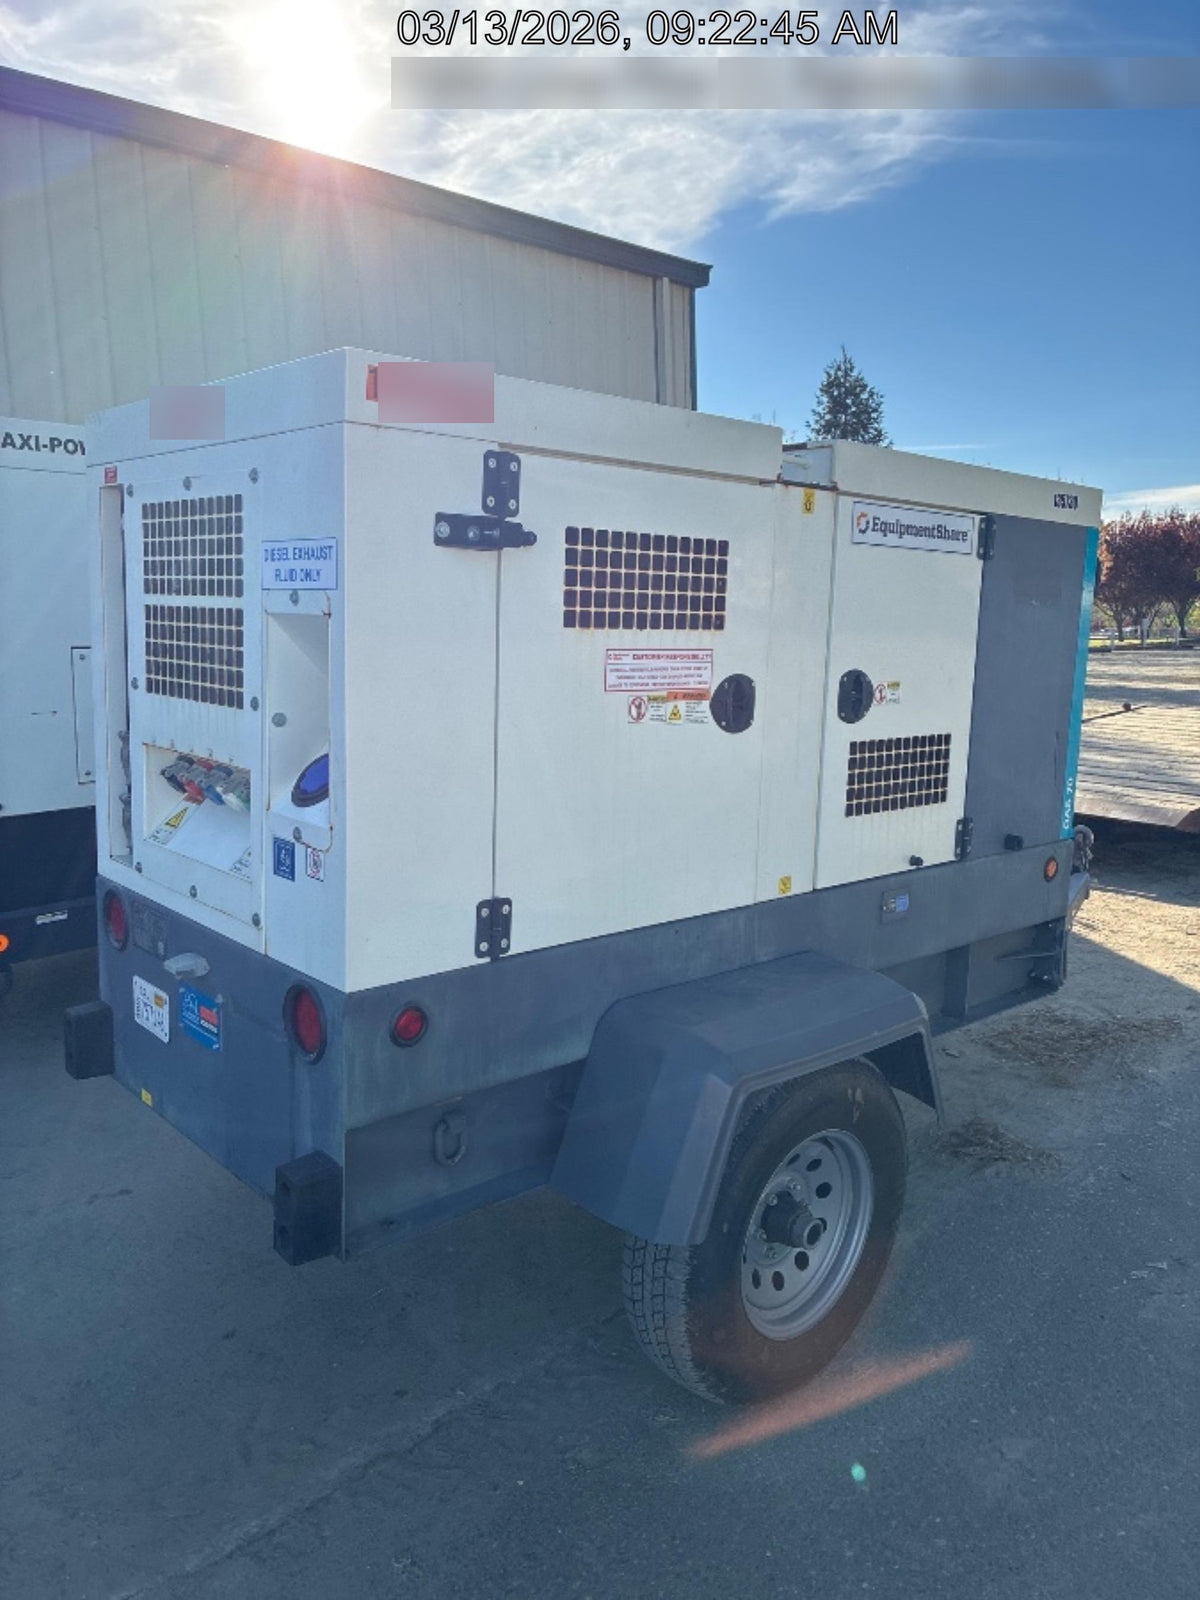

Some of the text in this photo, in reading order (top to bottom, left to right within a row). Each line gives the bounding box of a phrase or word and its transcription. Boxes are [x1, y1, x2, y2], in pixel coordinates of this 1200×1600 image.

[1, 431, 86, 456] AXI-PO
[871, 516, 968, 542] EquipmentShare
[264, 545, 333, 562] DIESEL EXHAUST
[275, 568, 298, 582] FLUID
